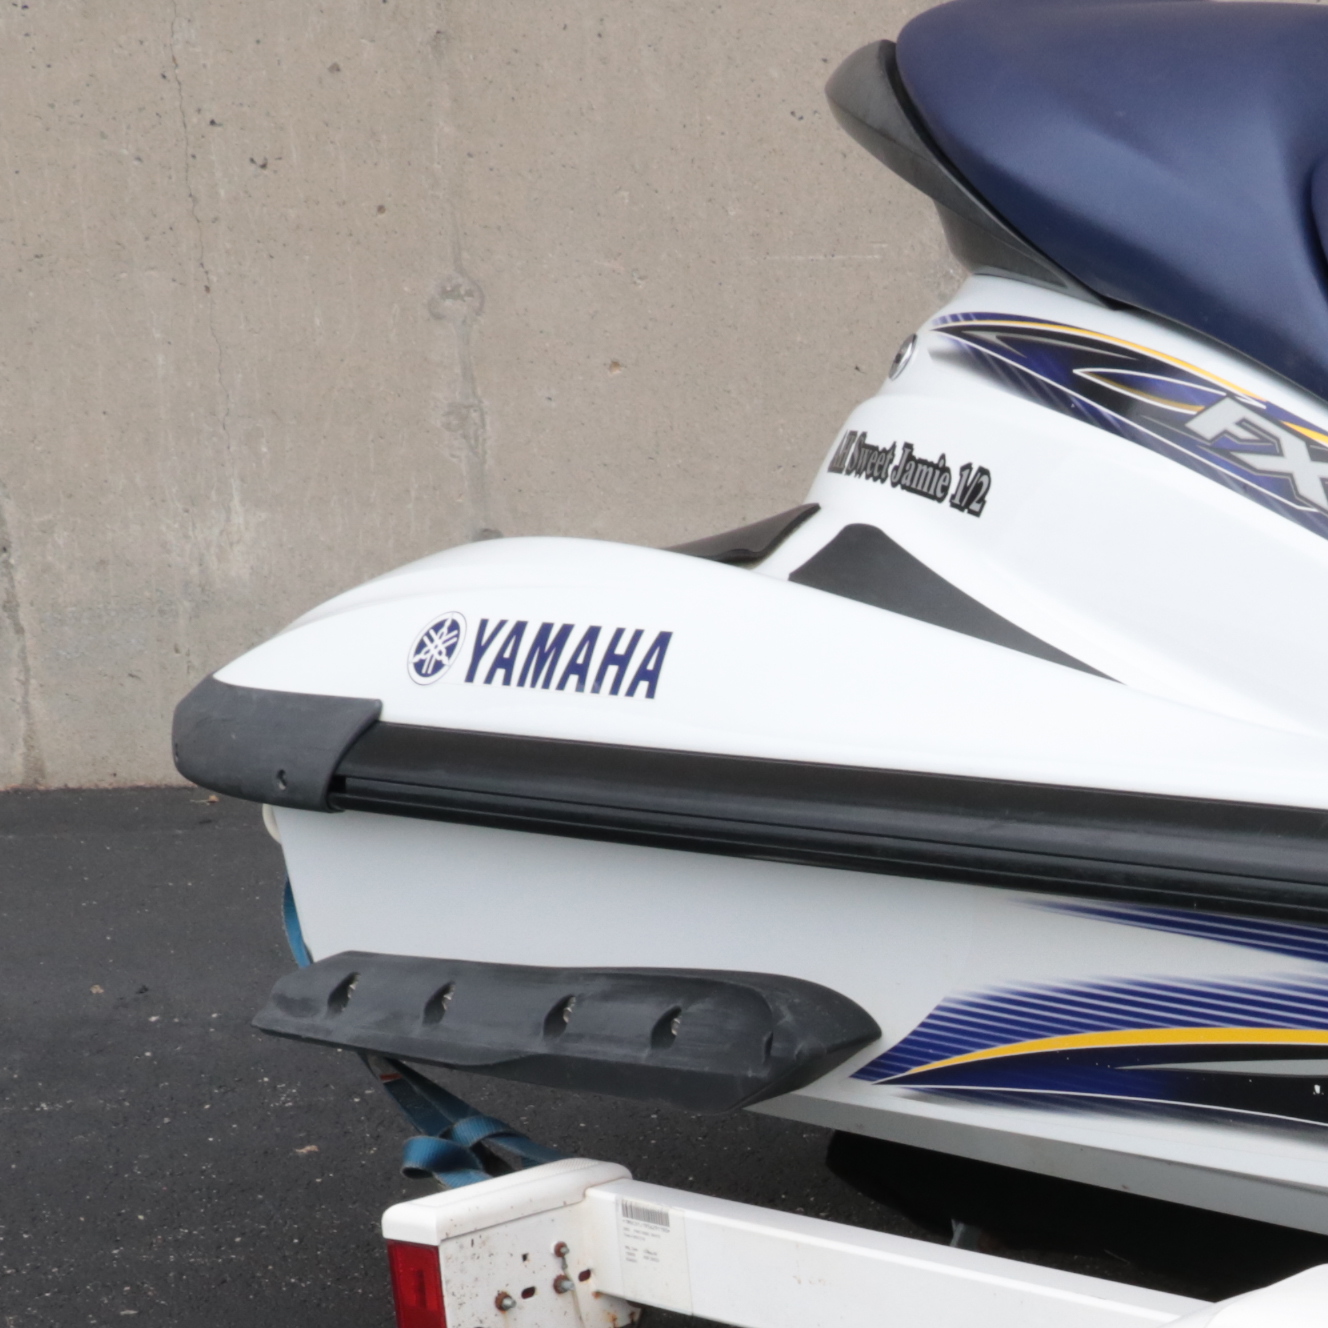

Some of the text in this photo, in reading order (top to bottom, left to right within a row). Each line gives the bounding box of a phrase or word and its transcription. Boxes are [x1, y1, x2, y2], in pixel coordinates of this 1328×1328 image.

[844, 430, 896, 484] Sweet
[890, 441, 951, 504] Jamie
[949, 462, 991, 518] 1/2
[464, 618, 674, 700] YAMAHA
